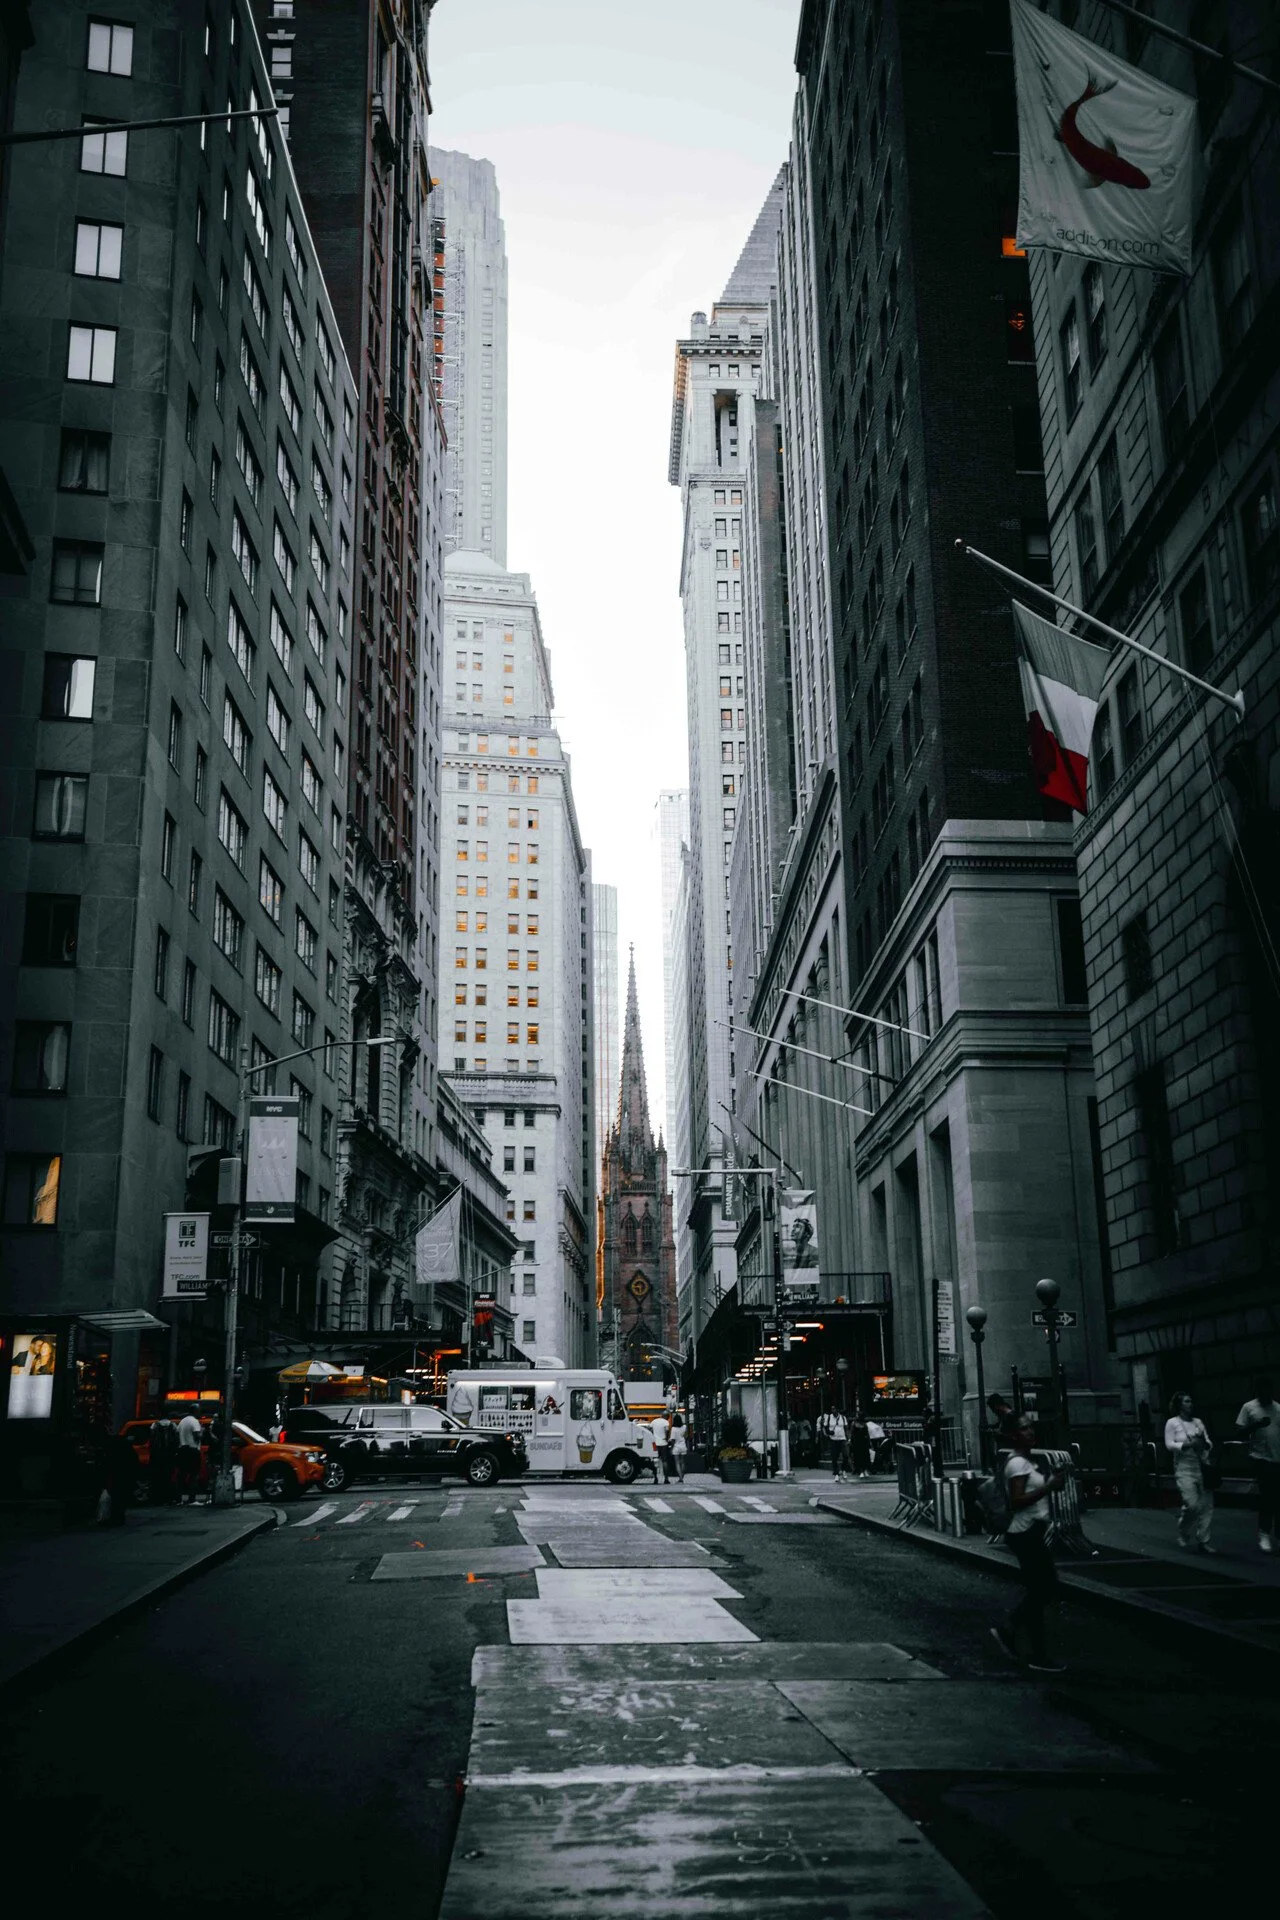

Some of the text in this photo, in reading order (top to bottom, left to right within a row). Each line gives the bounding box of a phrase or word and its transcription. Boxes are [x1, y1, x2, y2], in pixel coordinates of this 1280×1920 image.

[1056, 228, 1160, 255] addison.com
[265, 1105, 283, 1113] NYC
[724, 1152, 735, 1216] DUANE rede
[178, 1240, 196, 1248] TFC
[424, 1242, 454, 1259] 37
[179, 1282, 208, 1291] WILLIAM
[1094, 1485, 1102, 1495] 2
